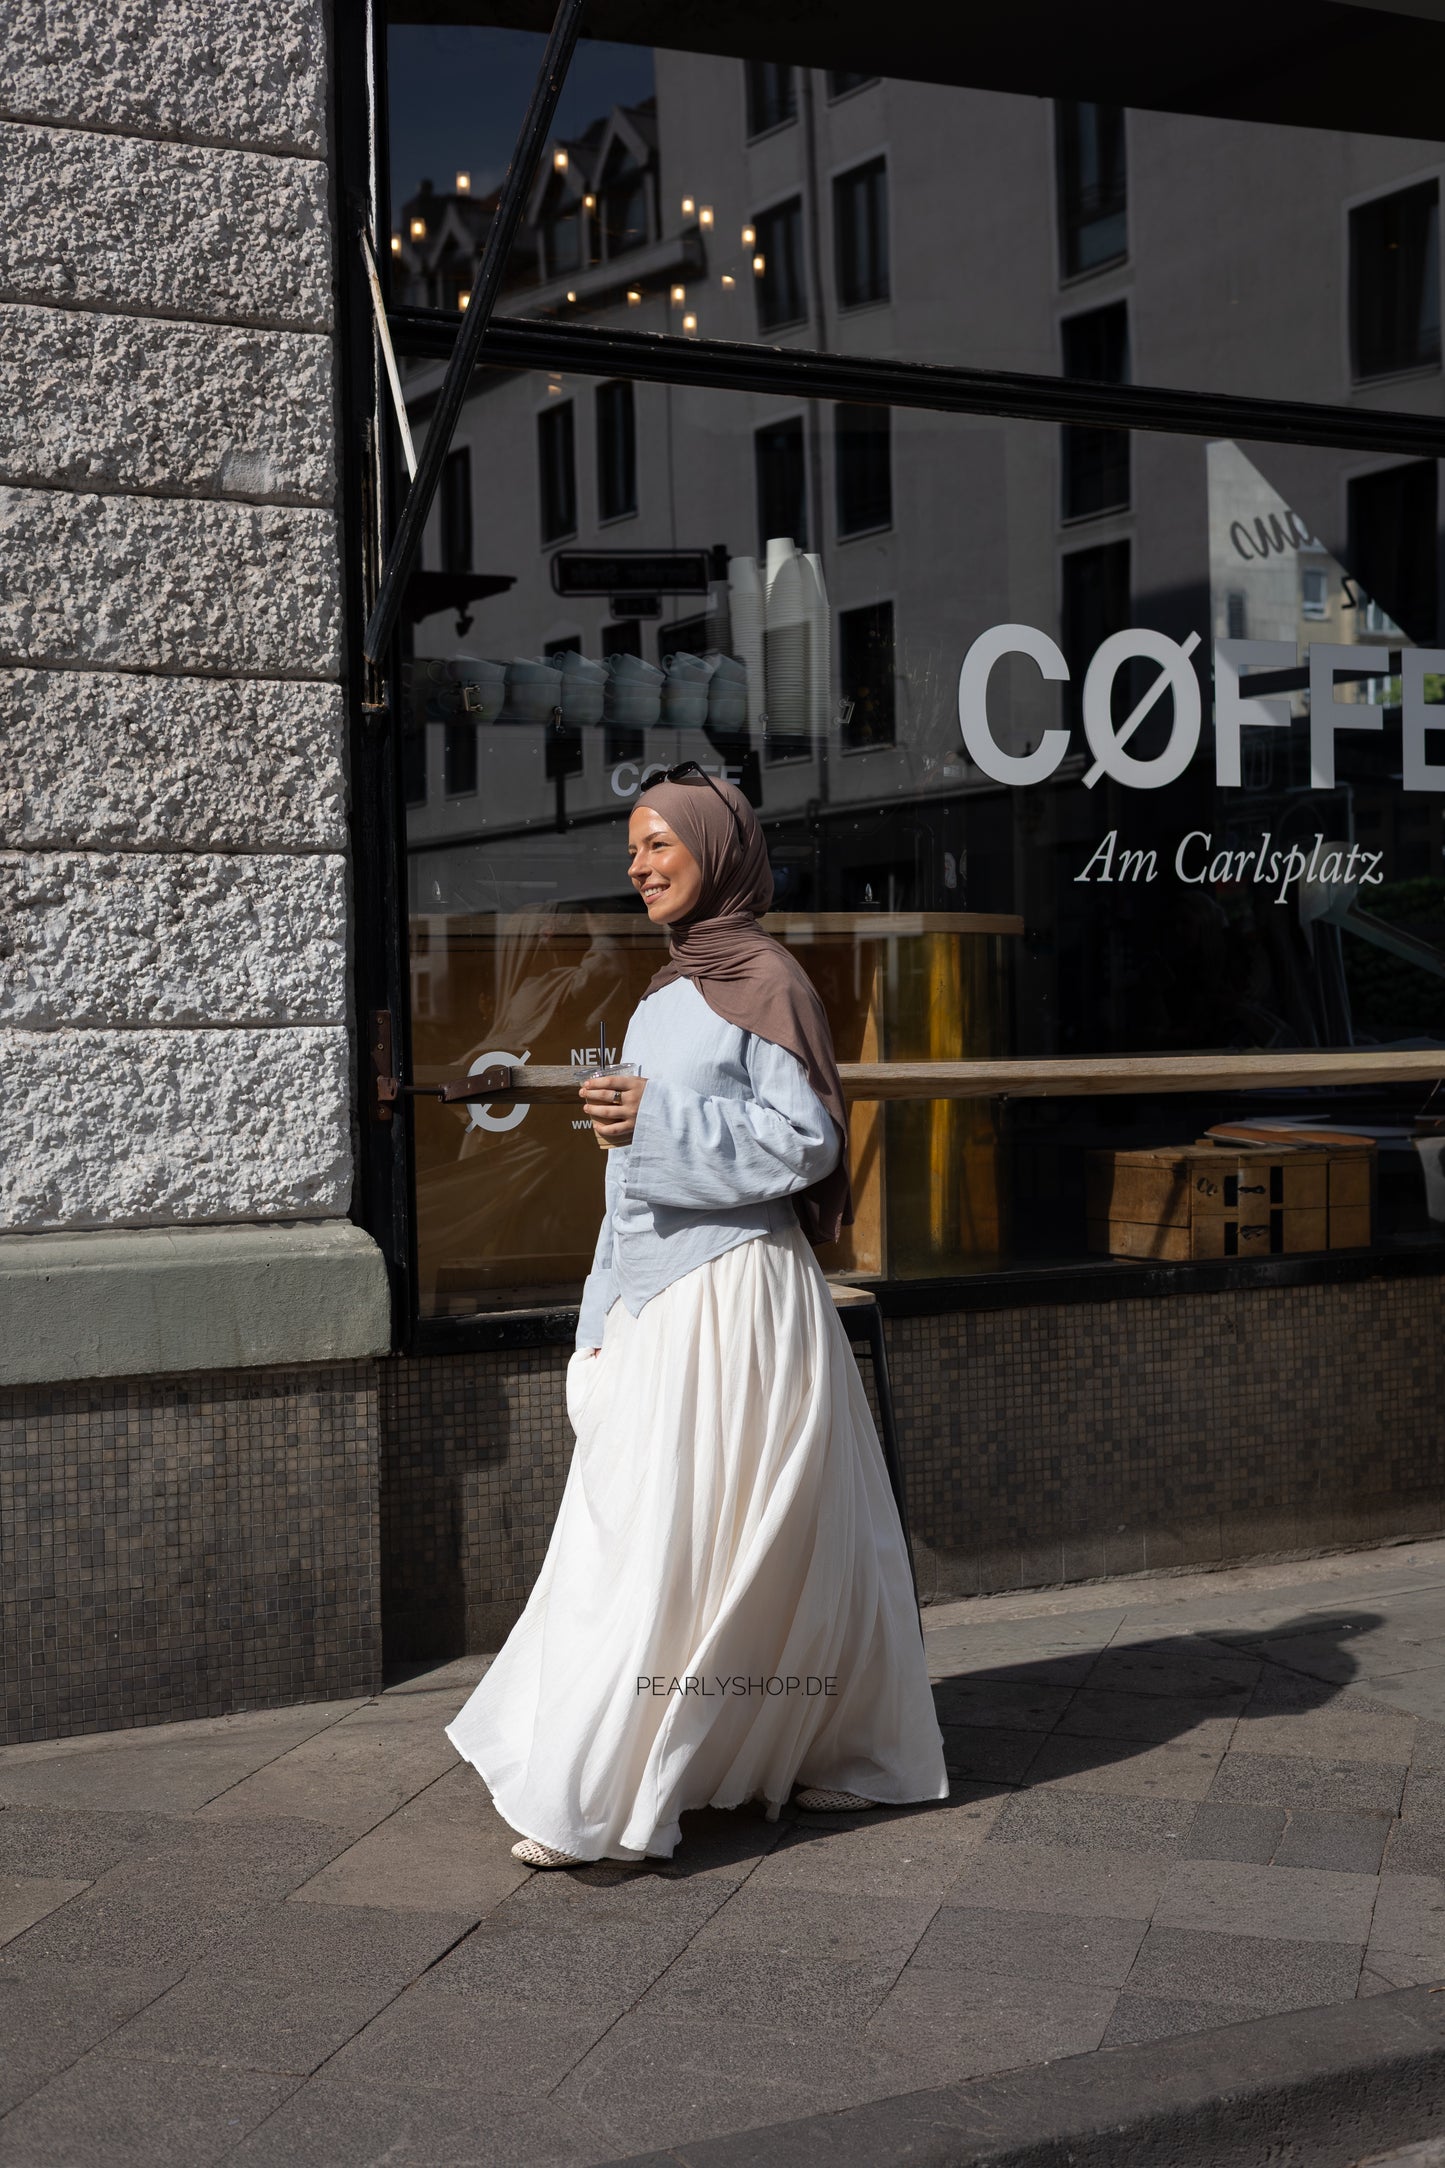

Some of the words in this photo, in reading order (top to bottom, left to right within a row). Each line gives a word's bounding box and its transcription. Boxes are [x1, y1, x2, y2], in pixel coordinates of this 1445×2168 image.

[1073, 829, 1159, 883] Am
[1175, 831, 1384, 904] Carlsplatz
[570, 1047, 617, 1066] NEW
